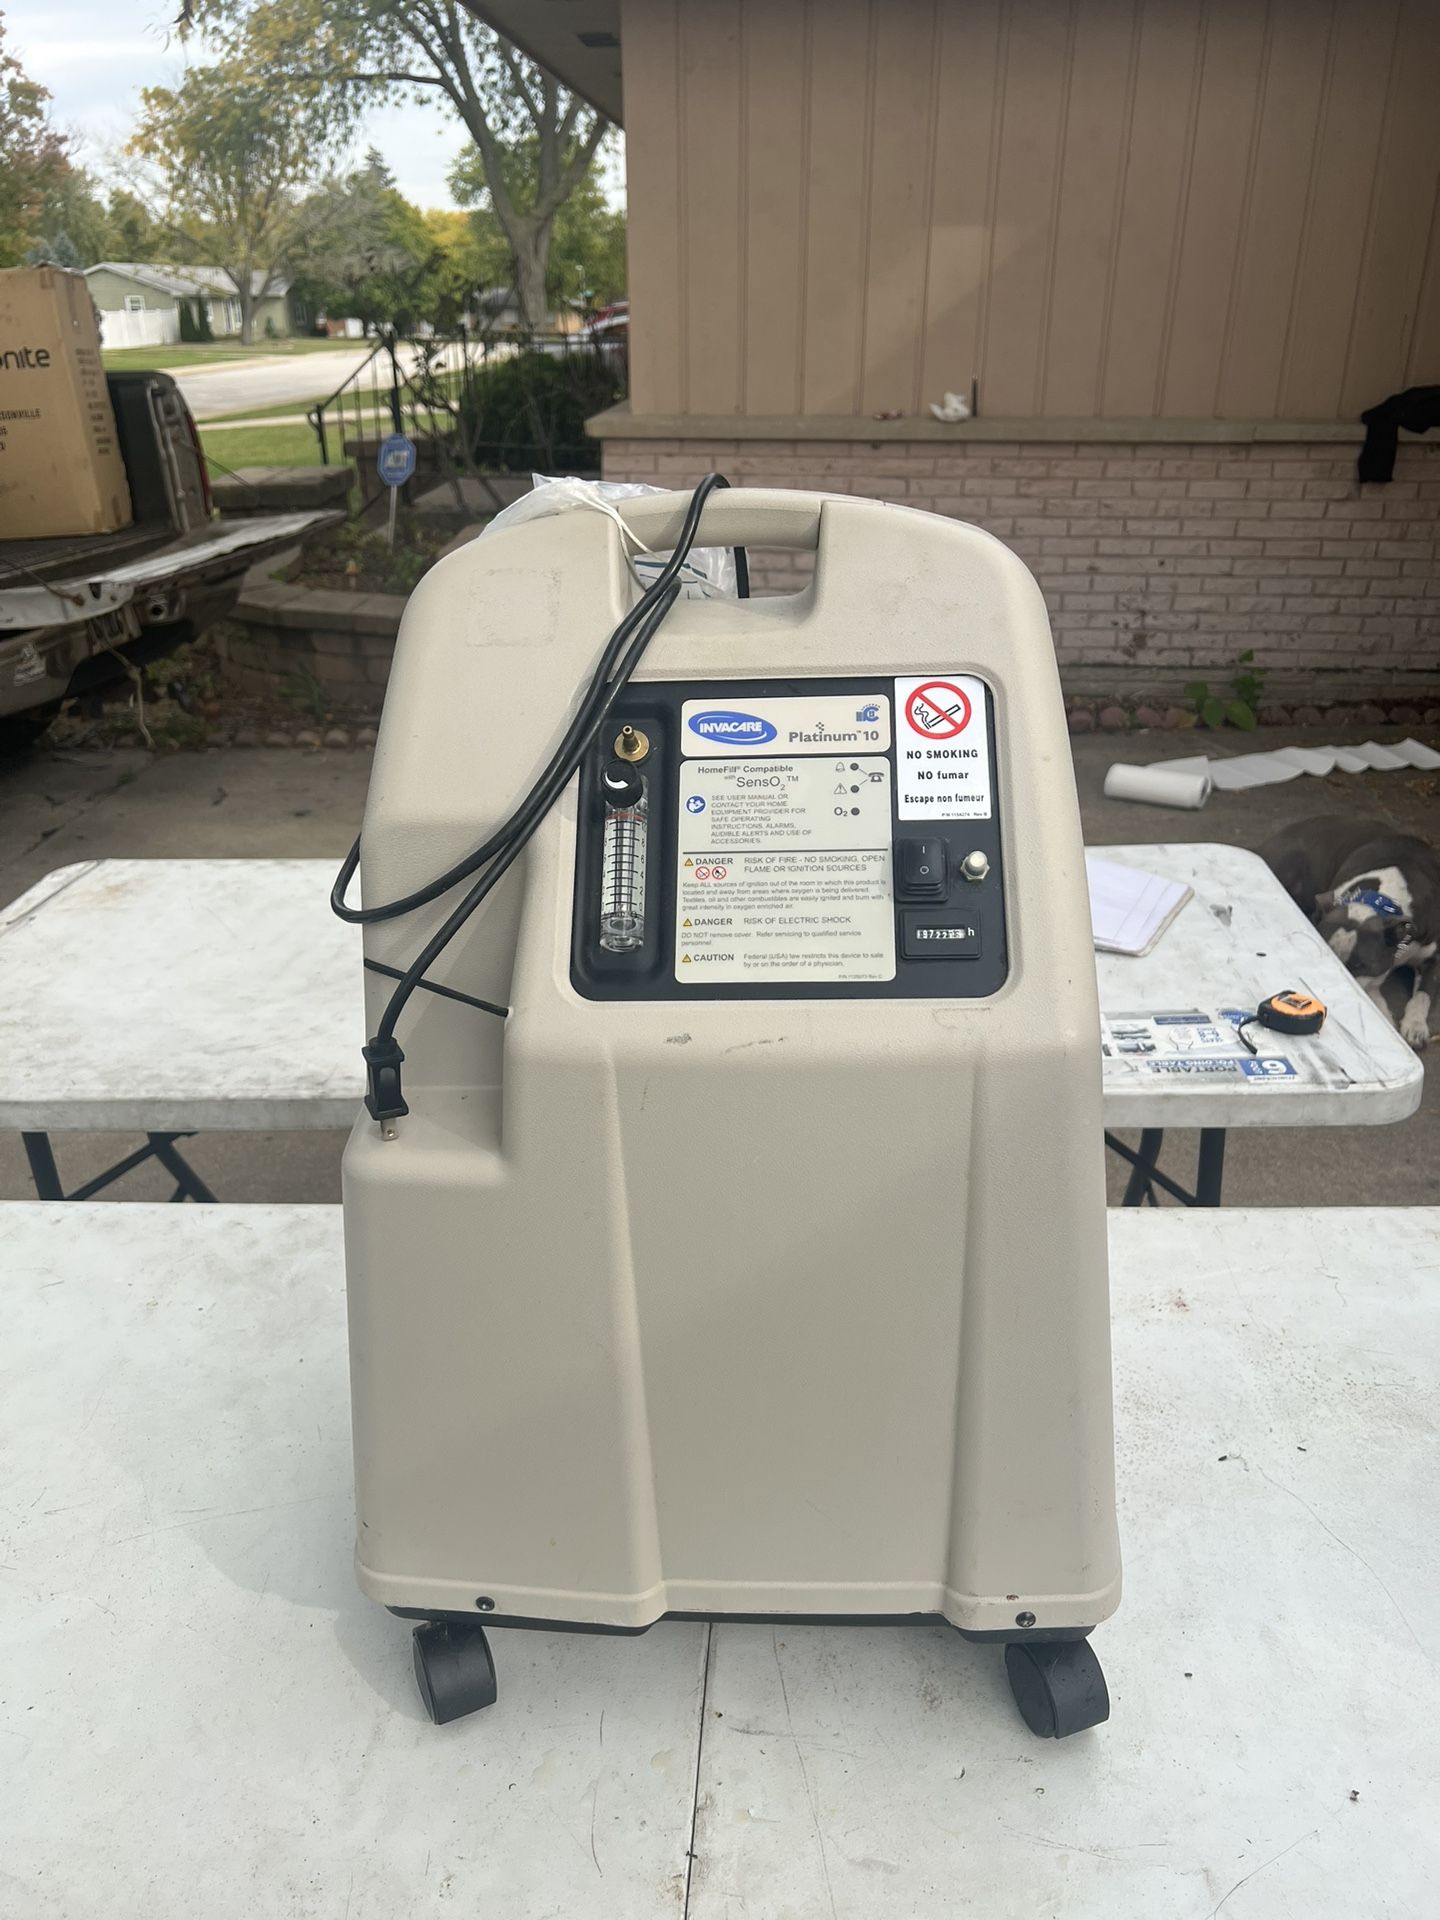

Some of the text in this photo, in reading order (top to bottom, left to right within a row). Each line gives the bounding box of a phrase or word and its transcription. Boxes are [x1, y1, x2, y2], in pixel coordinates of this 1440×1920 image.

[700, 721, 762, 733] INVACARE
[863, 731, 879, 741] 10
[907, 749, 978, 759] NO SMOKING
[743, 765, 793, 773] Compatible
[918, 771, 969, 780] NO fumar
[904, 794, 934, 804] Escape
[955, 793, 984, 802] fumeur
[821, 916, 851, 924] SHOCK
[967, 926, 975, 937] h
[1151, 1066, 1238, 1074] PORTABLE
[1261, 1059, 1287, 1075] 6
